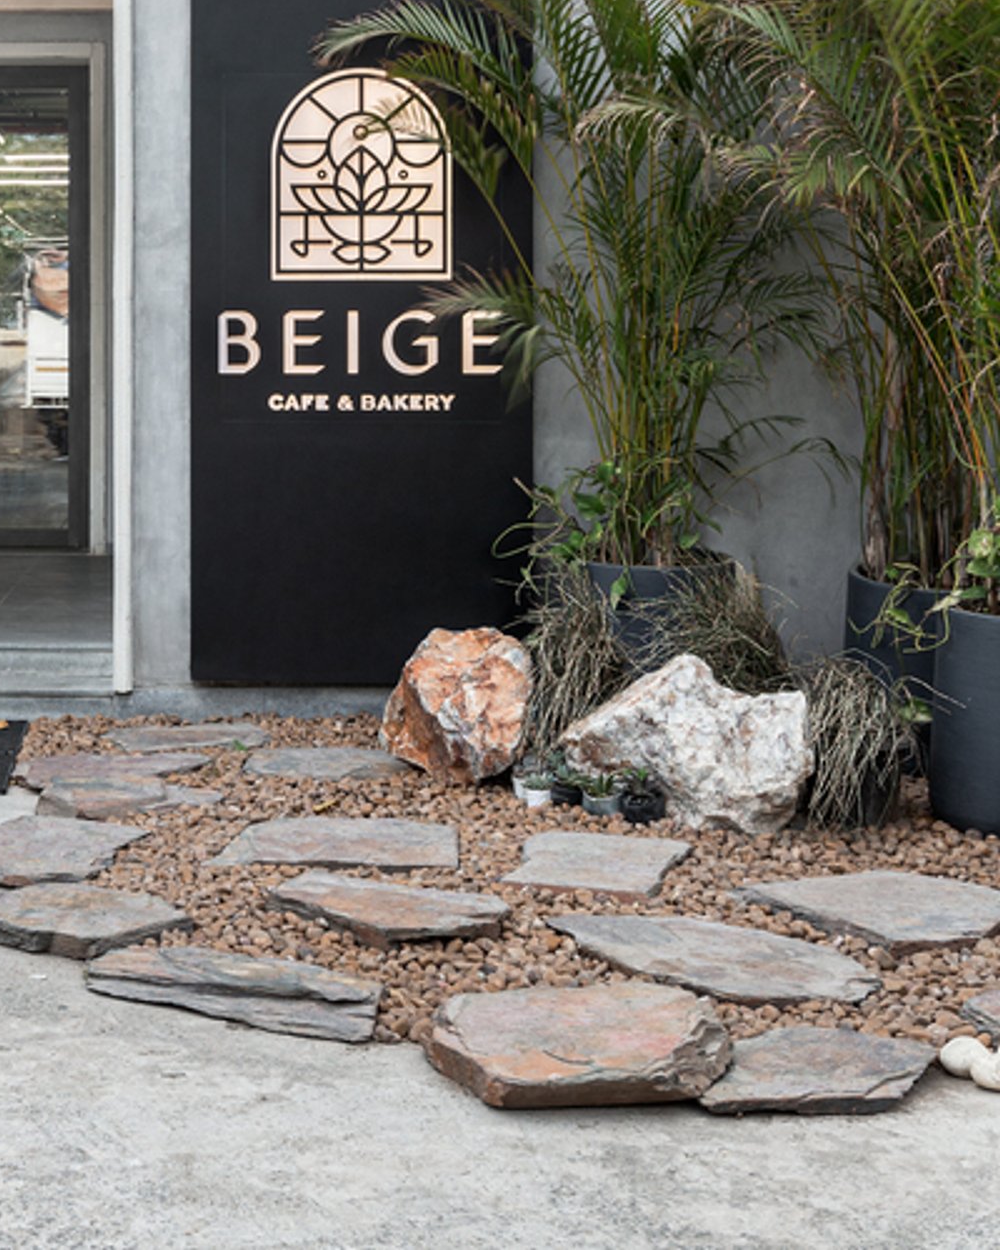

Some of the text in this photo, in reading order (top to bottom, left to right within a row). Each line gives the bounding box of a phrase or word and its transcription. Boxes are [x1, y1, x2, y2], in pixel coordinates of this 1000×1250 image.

[217, 309, 504, 375] BEIGE
[267, 393, 456, 412] CAFE & BAKERY
